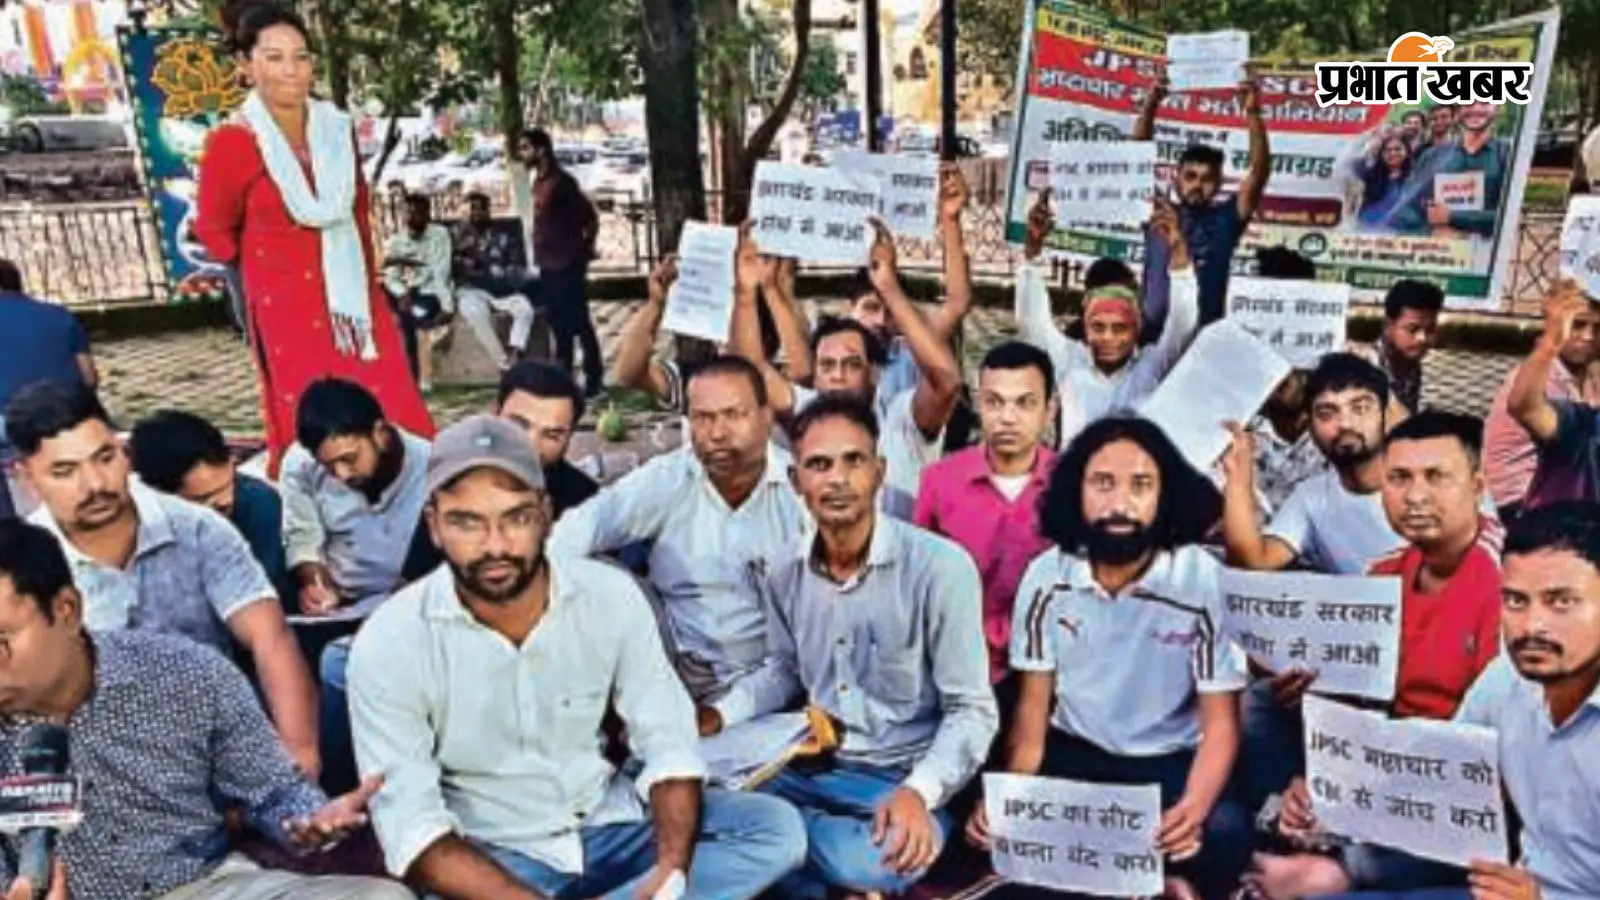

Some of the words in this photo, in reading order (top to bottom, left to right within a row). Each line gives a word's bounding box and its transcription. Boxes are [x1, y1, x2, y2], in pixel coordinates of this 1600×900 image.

[1226, 593, 1305, 619] झारखंड
[1315, 602, 1396, 625] सरकार
[1320, 641, 1381, 666] आओ
[1461, 756, 1495, 787] को
[1004, 799, 1057, 822] JPSC
[1450, 804, 1499, 834] करो
